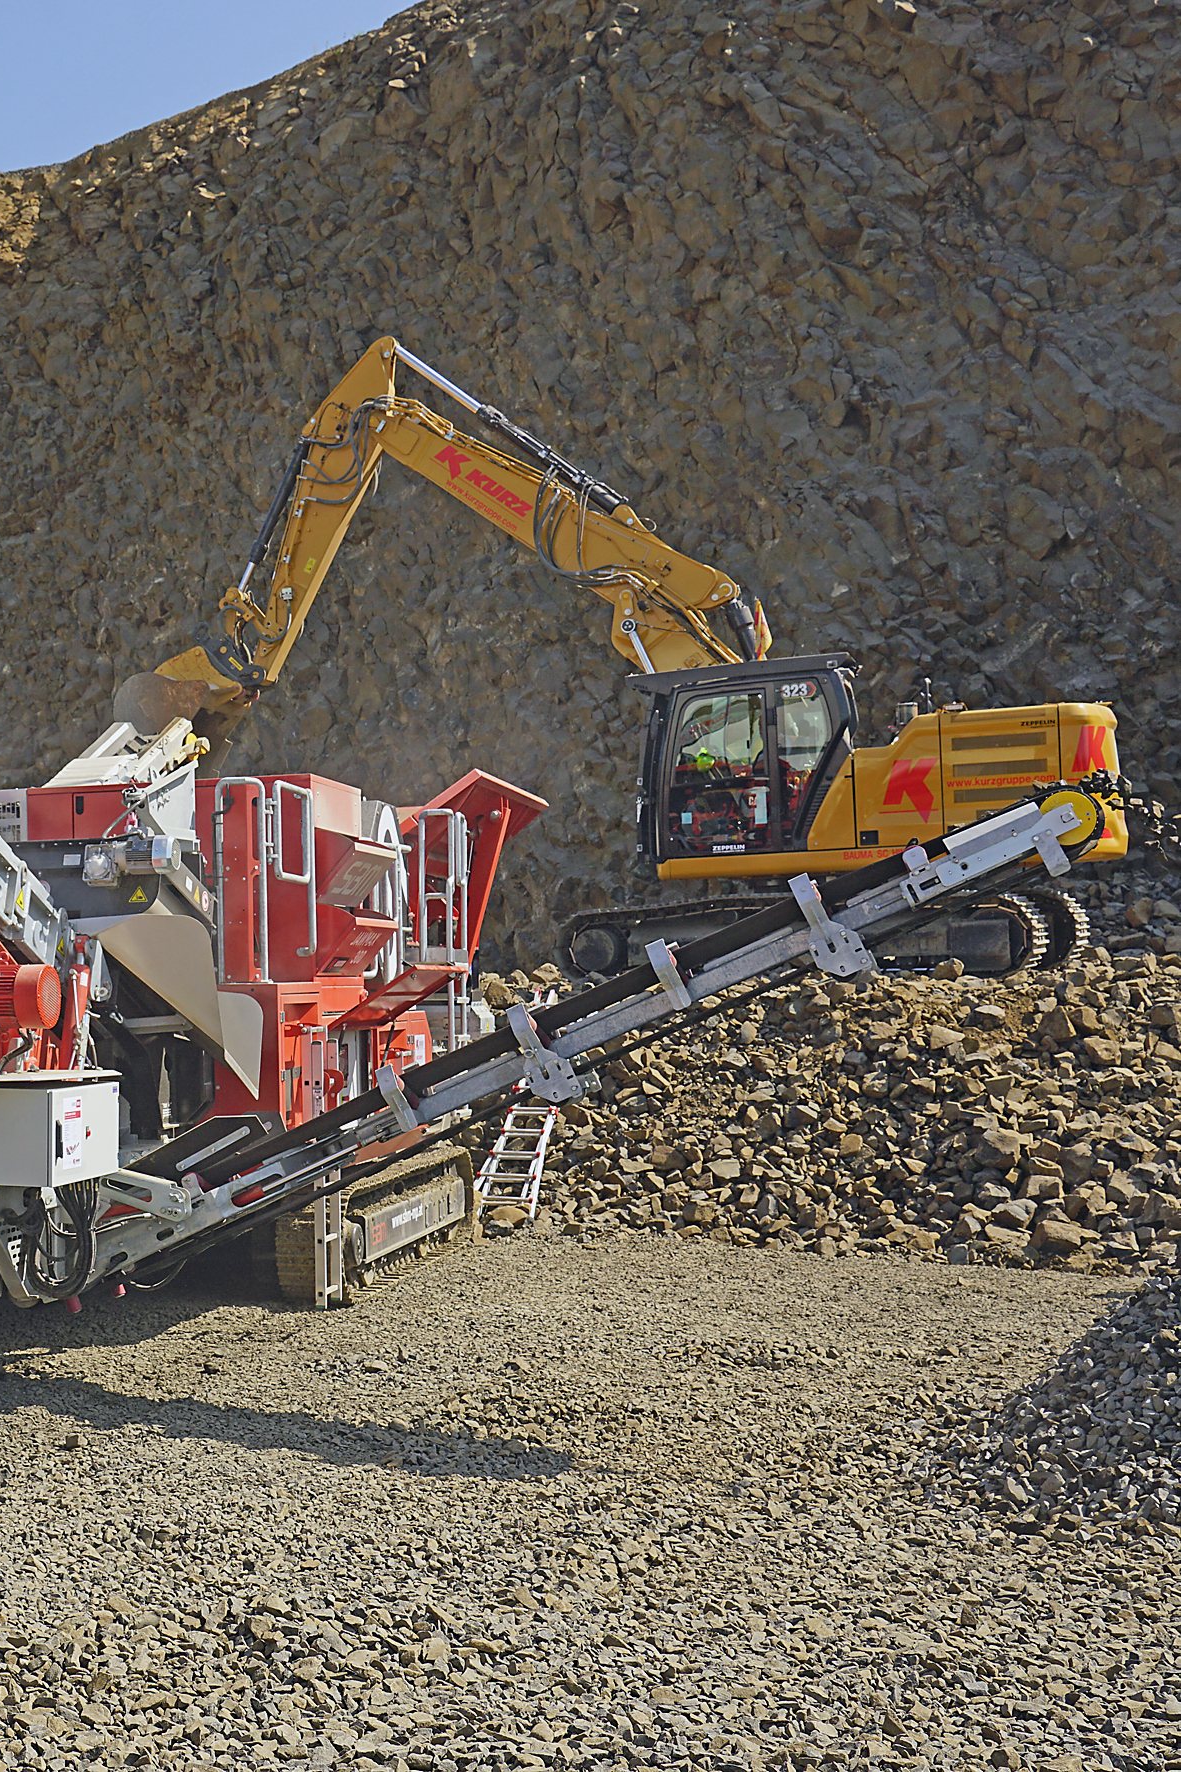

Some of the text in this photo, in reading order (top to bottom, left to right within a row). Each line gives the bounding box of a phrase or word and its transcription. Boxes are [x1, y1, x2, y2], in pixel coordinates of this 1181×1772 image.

[465, 468, 533, 518] KURZ
[446, 479, 518, 532] www.kurzgruppe.com
[782, 683, 808, 698] 323
[1020, 719, 1056, 727] ZEPPELIN
[946, 773, 1056, 788] www.kurzgruppe.com
[882, 757, 940, 824] K
[843, 850, 873, 860] BAUMA
[877, 849, 889, 859] SC
